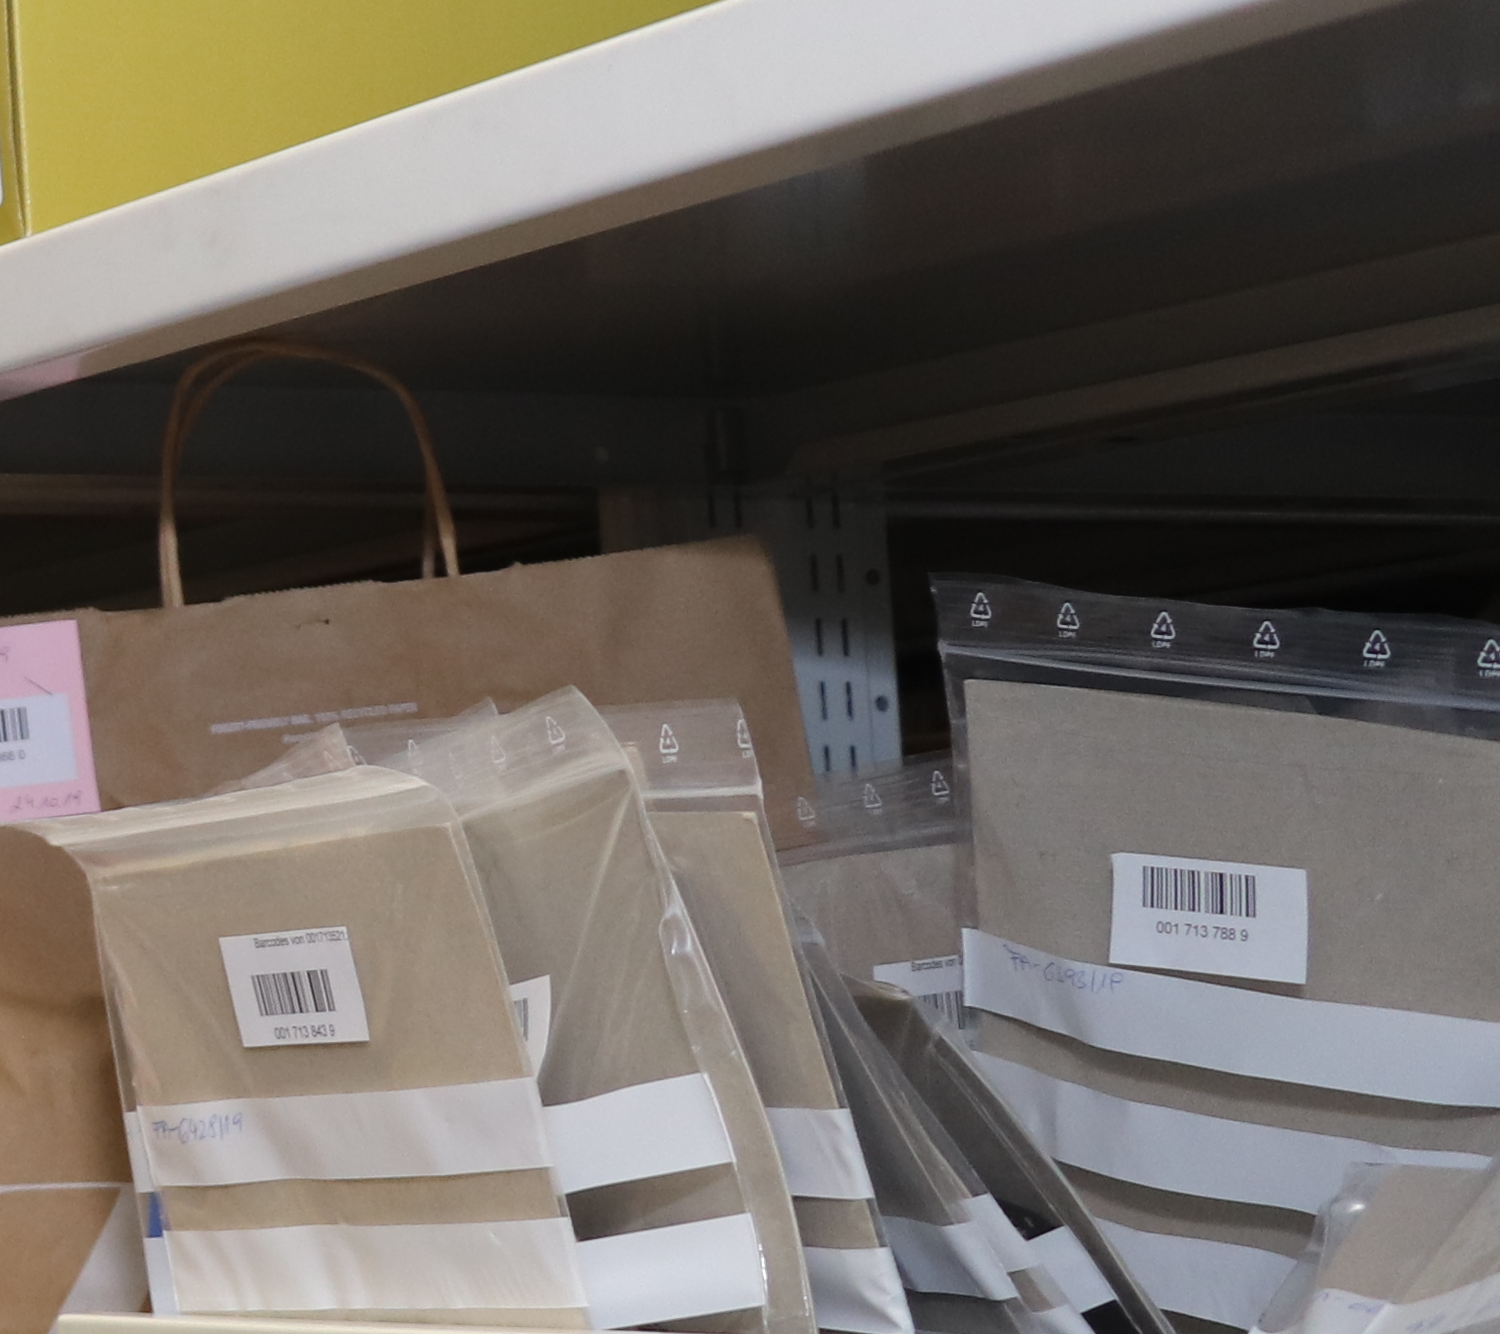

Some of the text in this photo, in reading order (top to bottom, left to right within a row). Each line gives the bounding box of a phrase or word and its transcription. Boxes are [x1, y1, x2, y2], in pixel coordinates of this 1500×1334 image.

[1156, 921, 1249, 942] 001 713 788 9
[274, 1026, 291, 1040] 001
[292, 1025, 310, 1039] 713
[329, 1023, 336, 1037] 9
